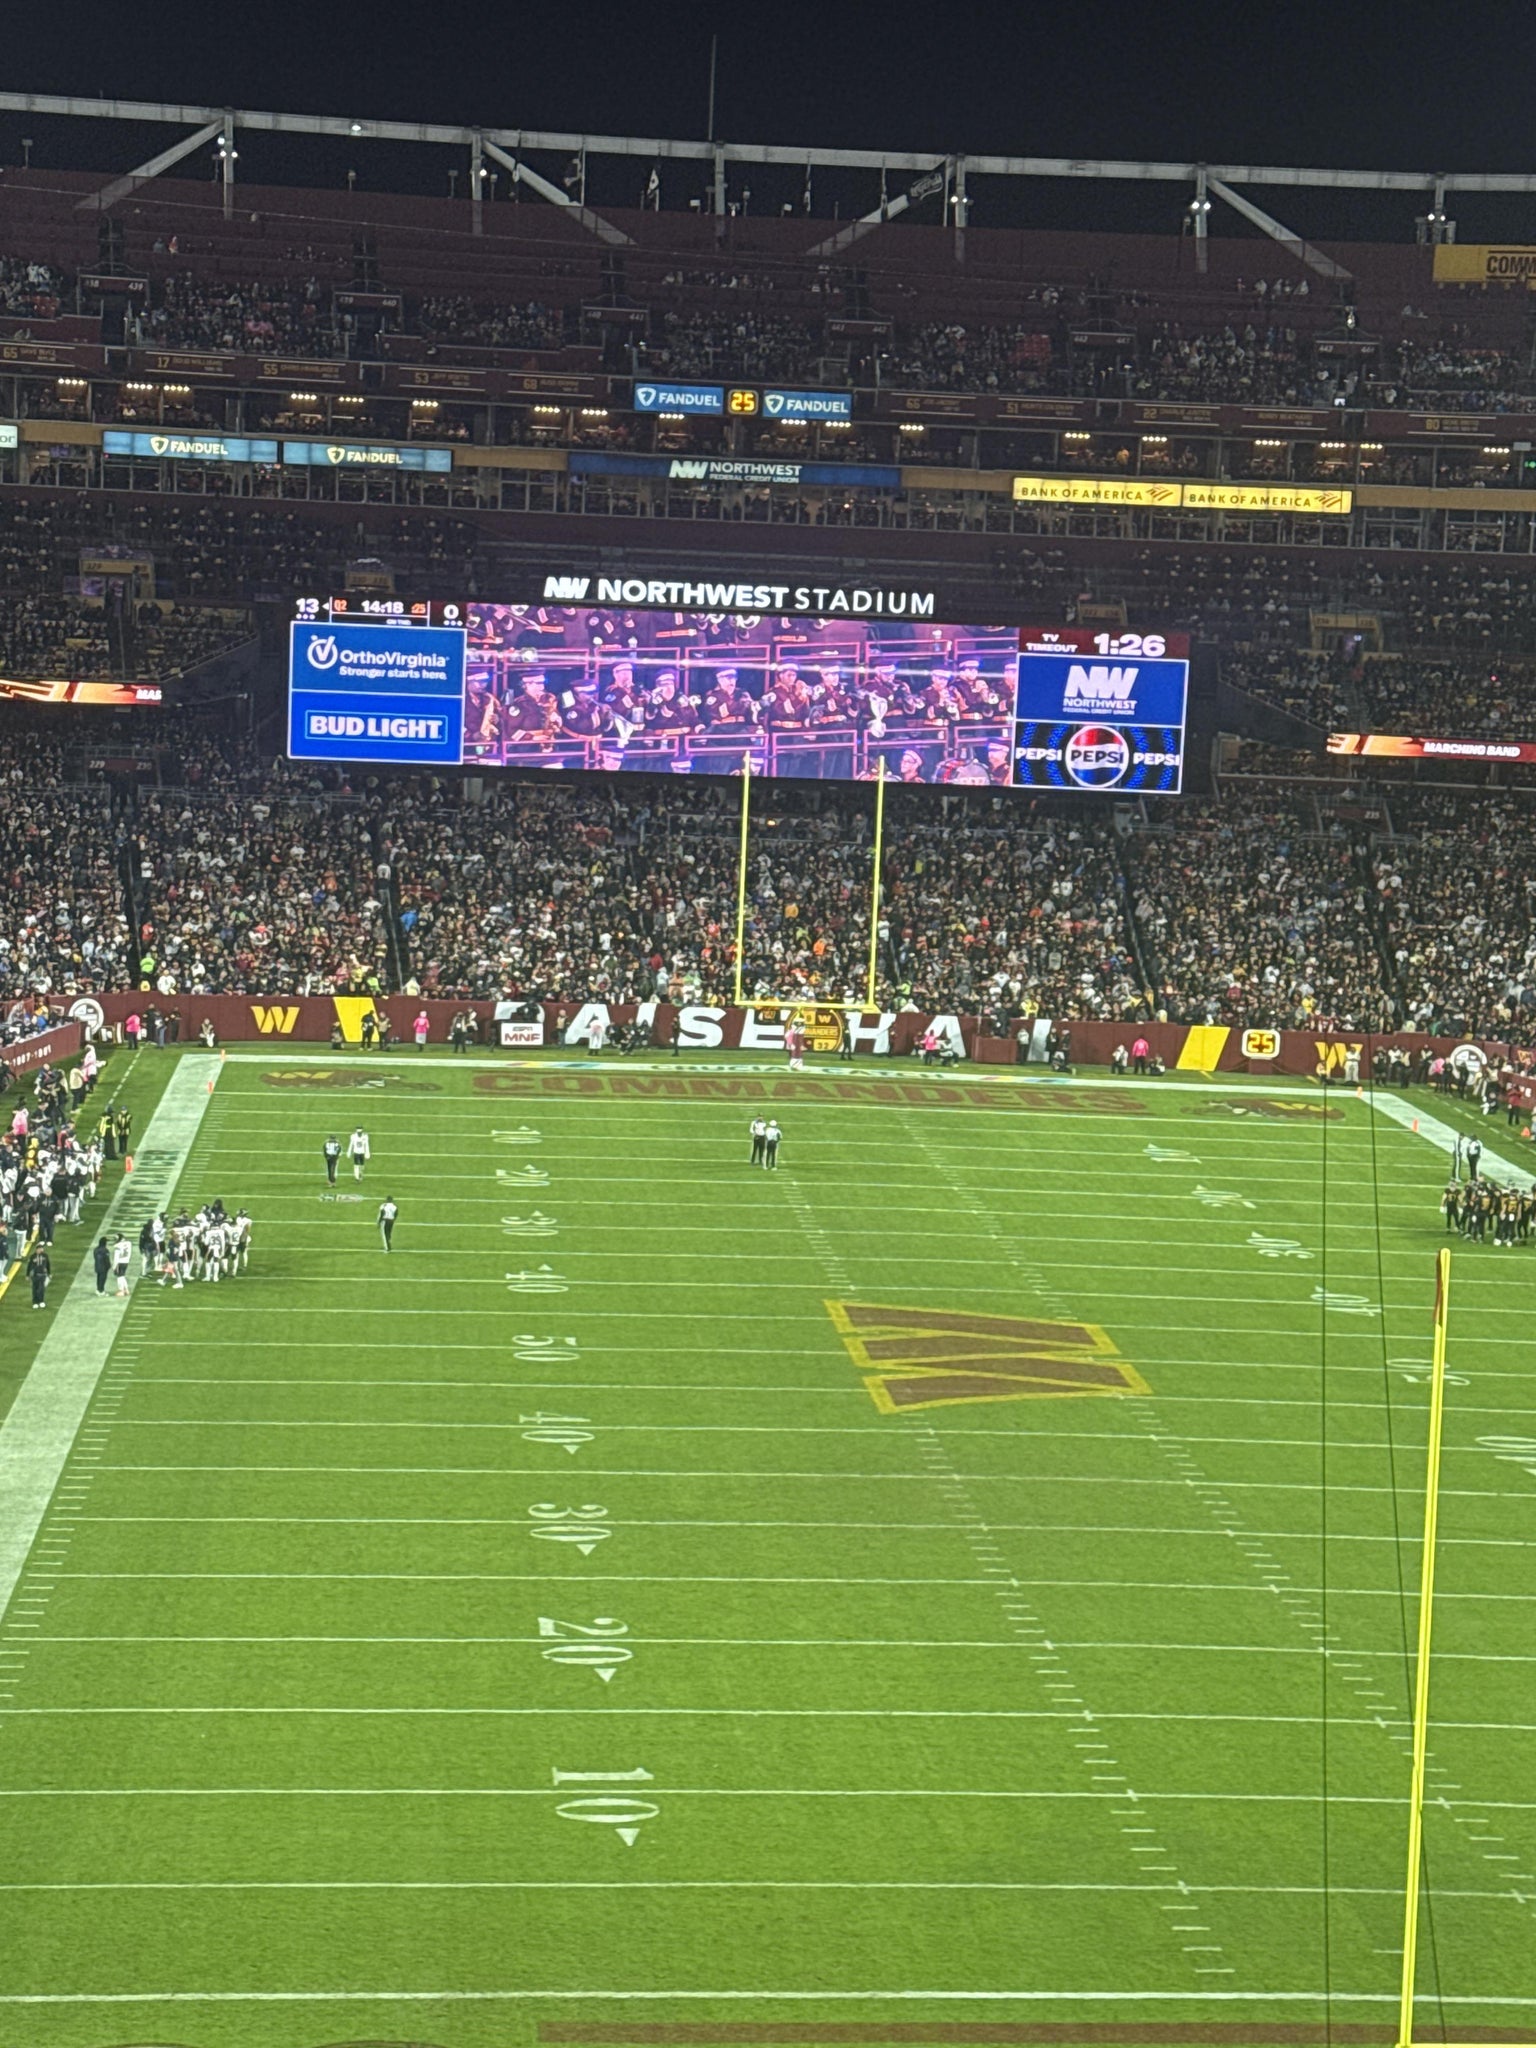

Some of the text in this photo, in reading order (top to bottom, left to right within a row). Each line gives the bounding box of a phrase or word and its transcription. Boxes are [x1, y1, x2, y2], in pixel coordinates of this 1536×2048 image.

[157, 356, 170, 369] 17
[263, 363, 278, 375] 55
[414, 372, 429, 384] 53
[658, 392, 720, 406] FANDUEL
[730, 392, 755, 411] 25
[786, 399, 849, 413] FANDUEL
[170, 441, 228, 455] FANDUEL
[346, 451, 404, 464] FANDUEL
[710, 462, 802, 476] NORTHWEST
[1021, 487, 1143, 500] BANK OF AMERICA
[1189, 494, 1311, 507] BANK OF AMERICA
[597, 578, 790, 609] NORTHWEST
[794, 587, 935, 615] STADIUM
[296, 598, 320, 613] 13
[361, 600, 404, 615] 14:18
[443, 604, 459, 619] 0
[1041, 633, 1059, 643] TV
[1093, 633, 1166, 657] 1:26
[1026, 643, 1078, 653] TIMEOUT
[340, 650, 447, 668] OrthoVirginia
[339, 666, 386, 678] Stronger
[387, 668, 421, 678] starts
[1063, 698, 1138, 710] NORTHWEST
[309, 715, 443, 739] BUD LIGHT
[1015, 747, 1062, 761] PEPSI
[1071, 749, 1123, 764] PEPSI
[1423, 742, 1520, 757] MARCHING BAND
[1133, 752, 1180, 766] PEPSI
[505, 1034, 540, 1042] MNF
[1247, 1033, 1274, 1053] 25
[472, 1073, 1148, 1110] COMMANDERS
